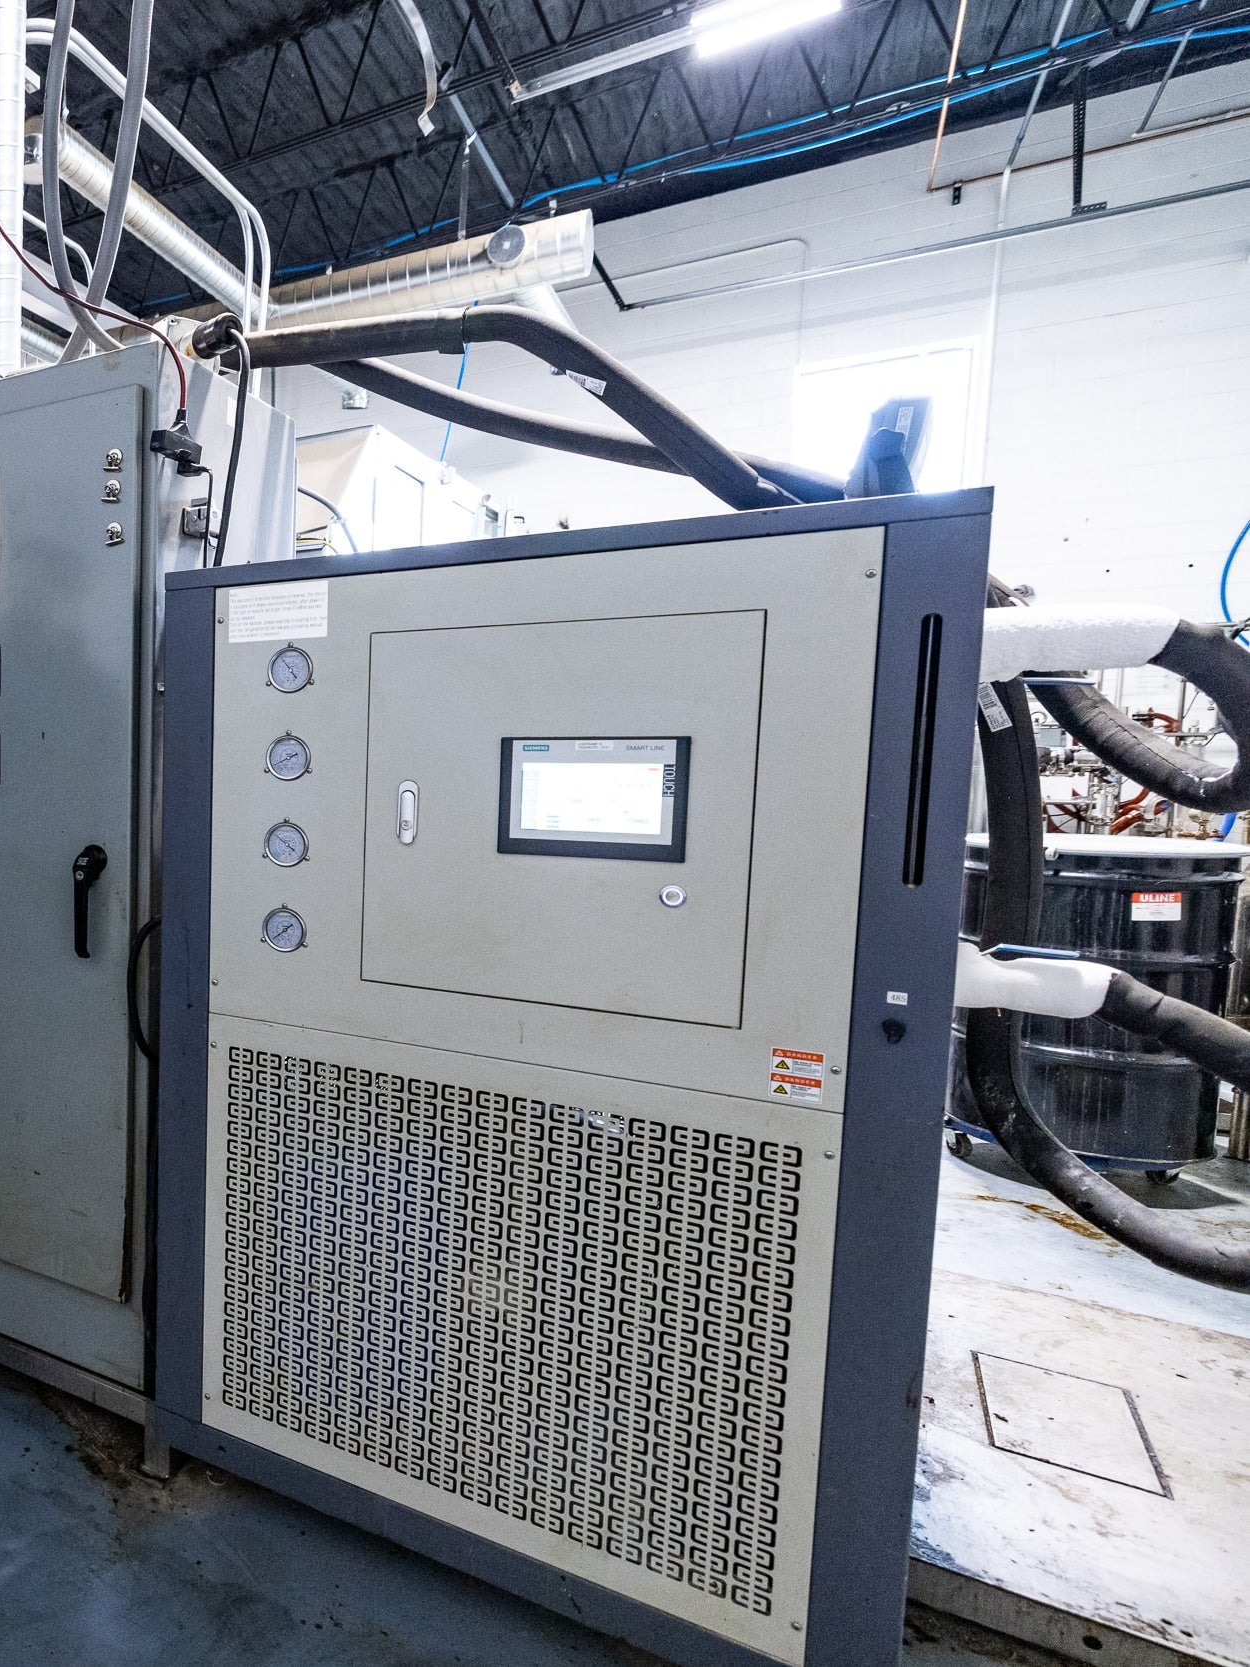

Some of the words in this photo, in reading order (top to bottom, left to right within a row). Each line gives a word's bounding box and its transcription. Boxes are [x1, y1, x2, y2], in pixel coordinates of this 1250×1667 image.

[663, 764, 675, 797] TOUCH
[1139, 893, 1176, 902] ULINE
[786, 1052, 817, 1060] DANGER
[784, 1076, 816, 1085] DANGER
